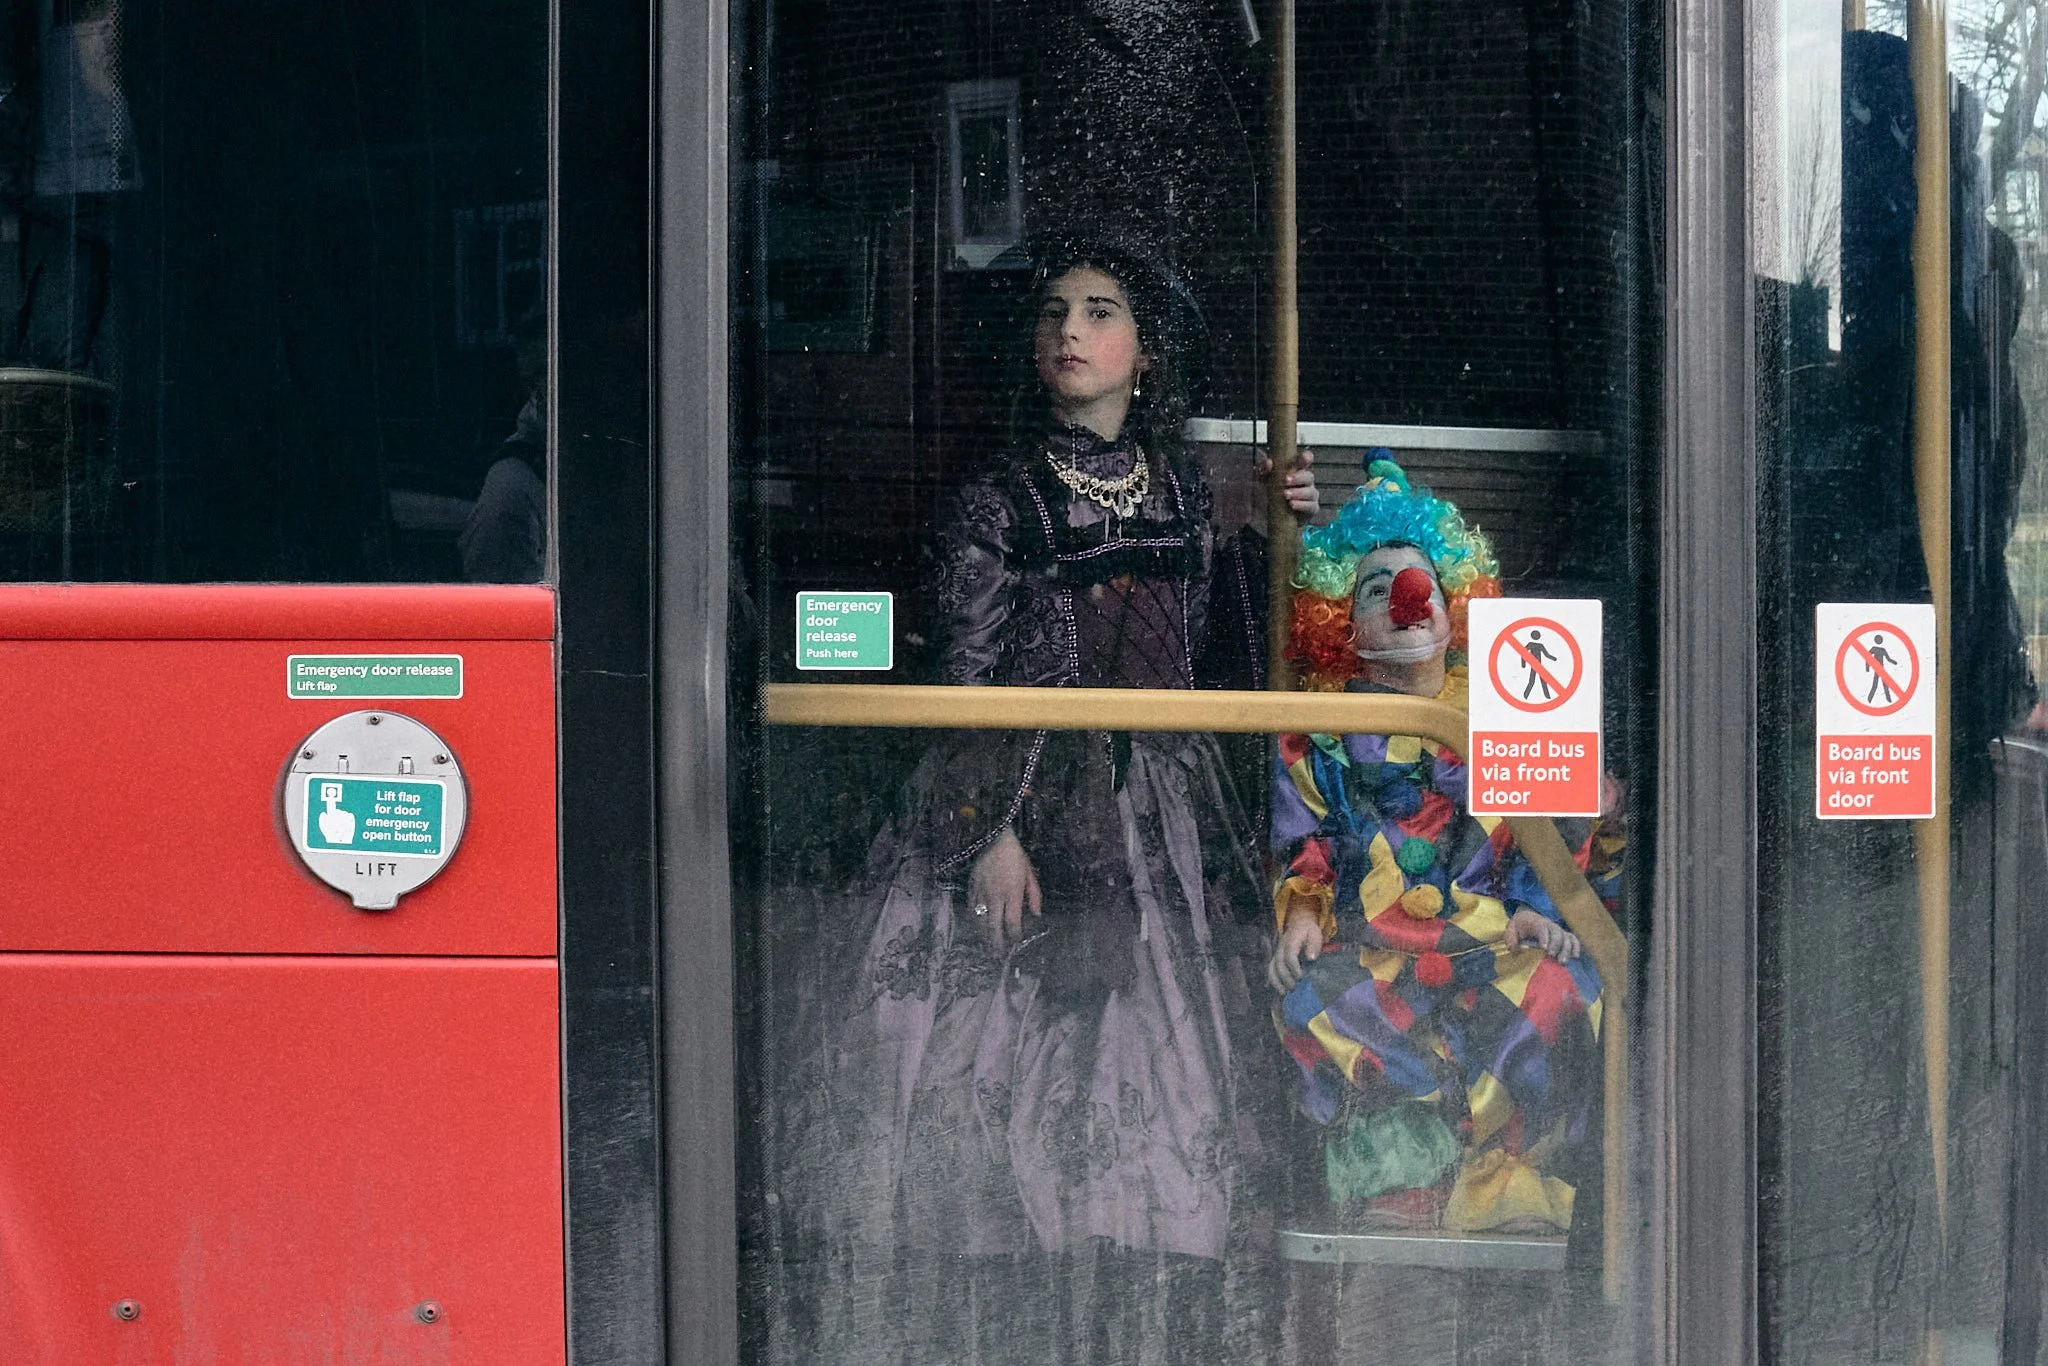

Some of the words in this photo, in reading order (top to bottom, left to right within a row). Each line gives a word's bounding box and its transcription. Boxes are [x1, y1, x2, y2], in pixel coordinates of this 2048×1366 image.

[806, 599, 882, 614] Emergency
[806, 614, 839, 627] door
[806, 630, 857, 642] release
[806, 648, 831, 658] Push
[834, 648, 859, 658] here
[297, 663, 368, 678] Emergency
[371, 663, 402, 676] door
[406, 663, 453, 676] release
[297, 681, 315, 691] Lift
[317, 681, 338, 693] flap
[1482, 739, 1541, 758] Board
[1548, 739, 1585, 758] bus
[1828, 743, 1883, 761] Board
[1889, 743, 1921, 761] bus
[1481, 763, 1511, 781] via
[1517, 763, 1571, 782] front
[1828, 767, 1855, 785] via
[1861, 766, 1909, 785] front
[376, 790, 396, 801] Lift
[398, 791, 420, 805] flap
[1481, 787, 1531, 805] door
[1828, 790, 1874, 808] door
[374, 803, 391, 814] for
[394, 805, 421, 815] door
[365, 818, 429, 831] emergency
[362, 831, 391, 842] open
[394, 831, 431, 843] button
[355, 862, 397, 876] LIFT
